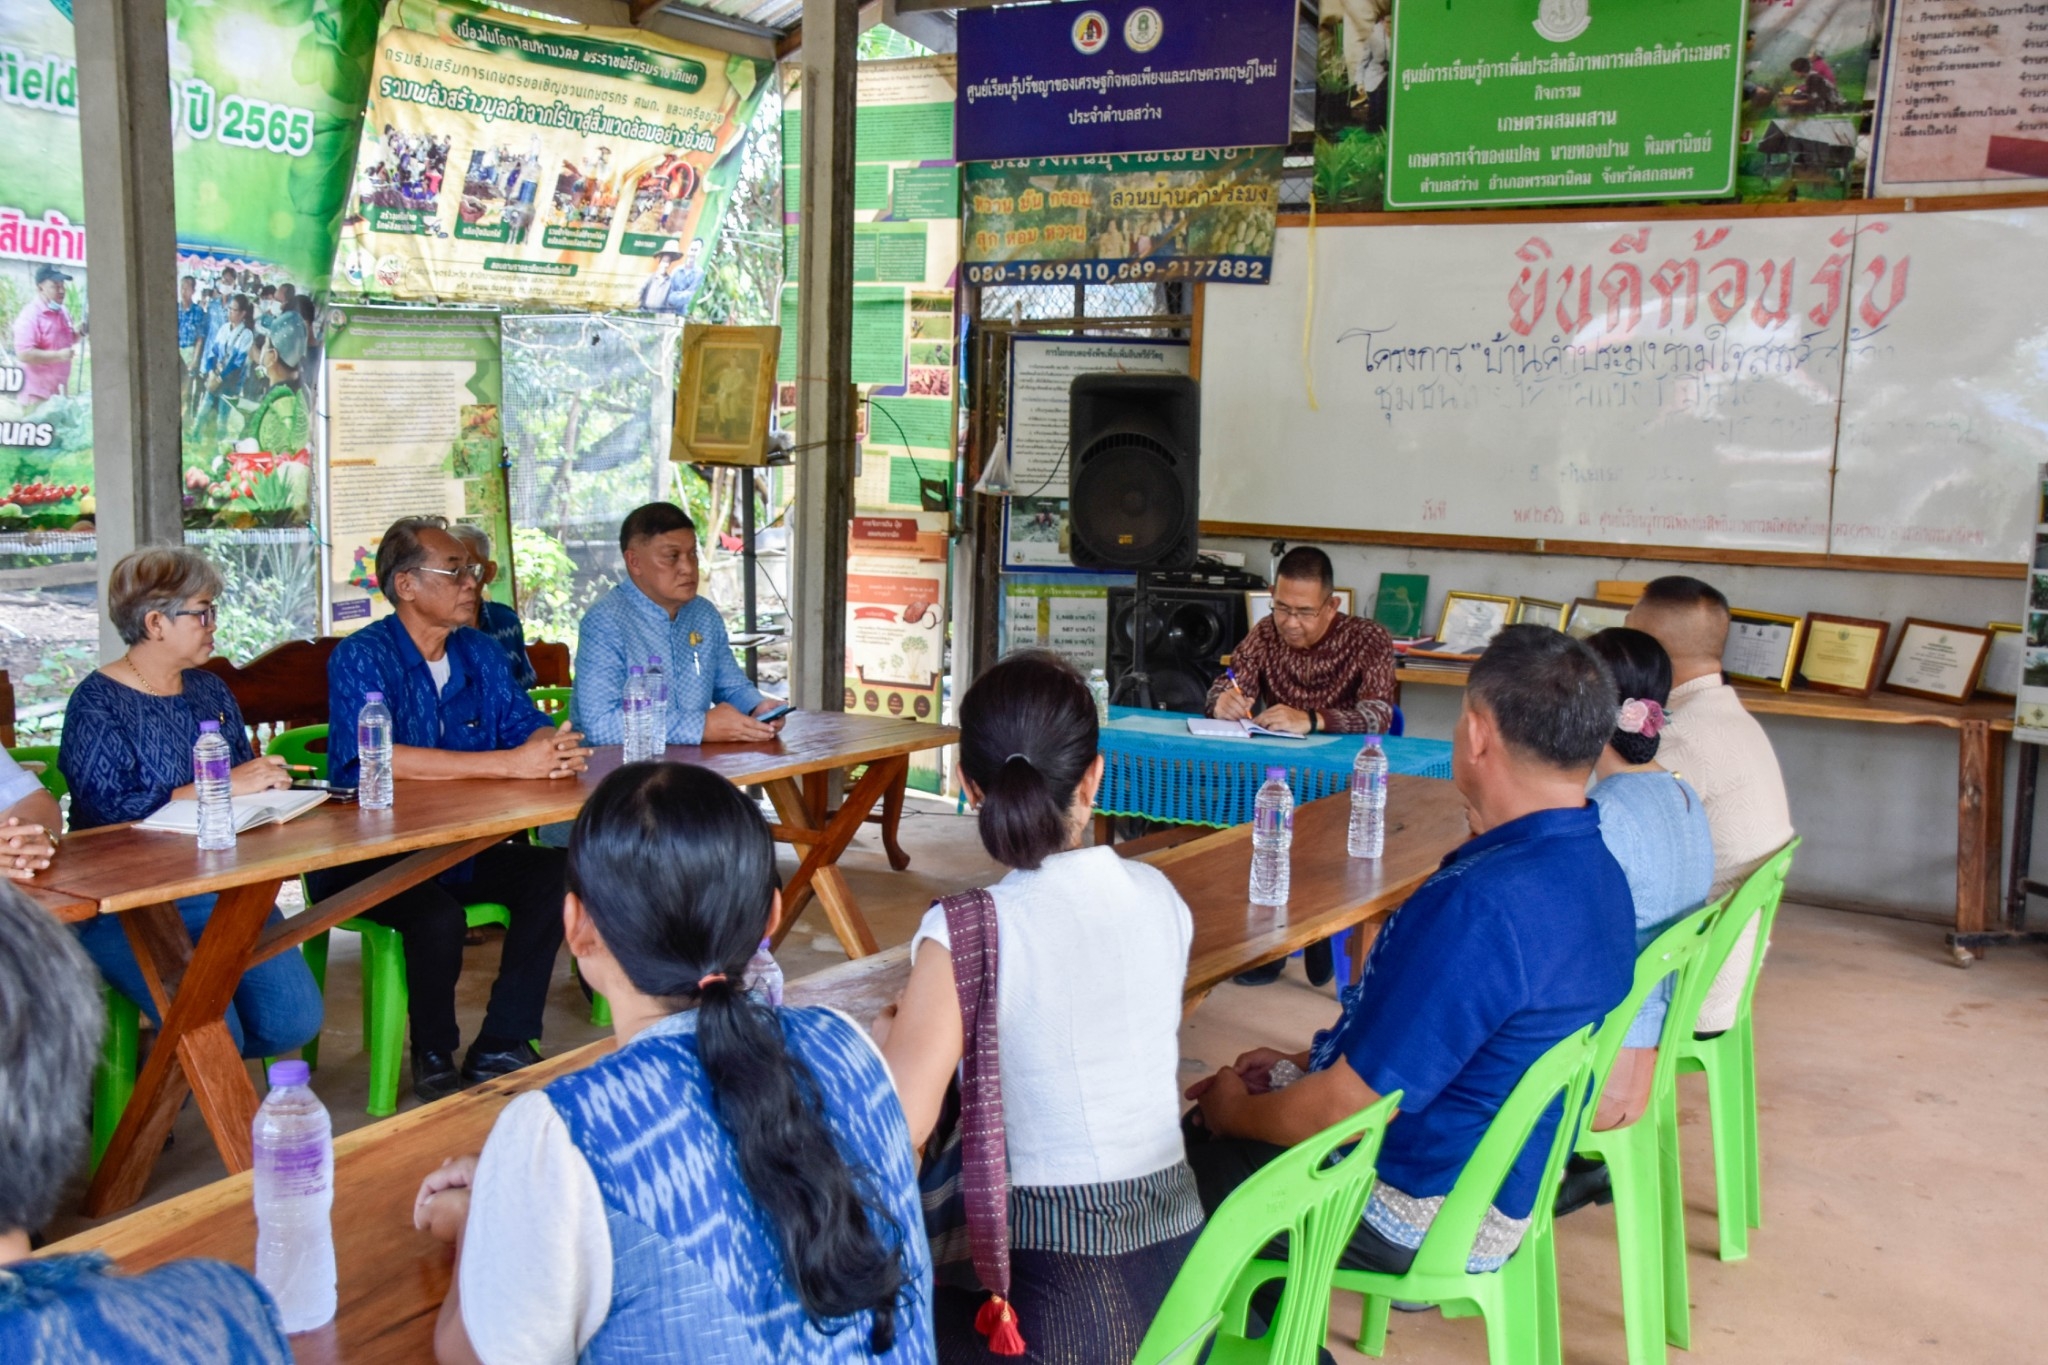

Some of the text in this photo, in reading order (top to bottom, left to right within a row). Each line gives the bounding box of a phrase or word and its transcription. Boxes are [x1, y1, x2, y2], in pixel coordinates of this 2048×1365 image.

[457, 19, 698, 85] เนื่องในโอกาสมหามงคล พระราชพิธีบรมราชาภิเษก
[1402, 42, 1731, 91] ศูนย์การเรียนรู้การเพิ่มประสิทธิภาพการผลิตสินค้าเกษตร
[0, 52, 76, 107] ield
[384, 48, 628, 105] กรมส่งเสริมการเกษตรขอเชิญชวนเกษตรกร
[666, 103, 724, 125] และเครือข่าย
[966, 58, 1278, 104] ศูนย์เรียนรู้ปรัชญาของเศรษฐกิจพอเพียงและเกษตรทฤษฎีใหม่
[1534, 84, 1581, 101] กิจกรรม
[186, 84, 310, 151] ปี 2565
[380, 76, 717, 153] รวมพลังสร้างมูลค่าจากไร่นาสู่สิ่งแวดล้อมอย่างยั่งยืน
[1068, 103, 1162, 125] ประจำตำบลสว่าง
[1498, 110, 1617, 132] เกษตรผสมผสาน
[1408, 144, 1540, 168] เกษตรกรเจ้าของแปลง
[1551, 138, 1629, 161] นายทองปาน
[974, 189, 1091, 214] หวาน มัน กรอบ
[1420, 165, 1694, 193] ตำบลสว่าง อำเภอพรรณานิคม จังหวัดสกลนคร
[976, 224, 1087, 253] สุก หอม หวาน
[1507, 221, 1911, 337] ยินดีต้อนรับ
